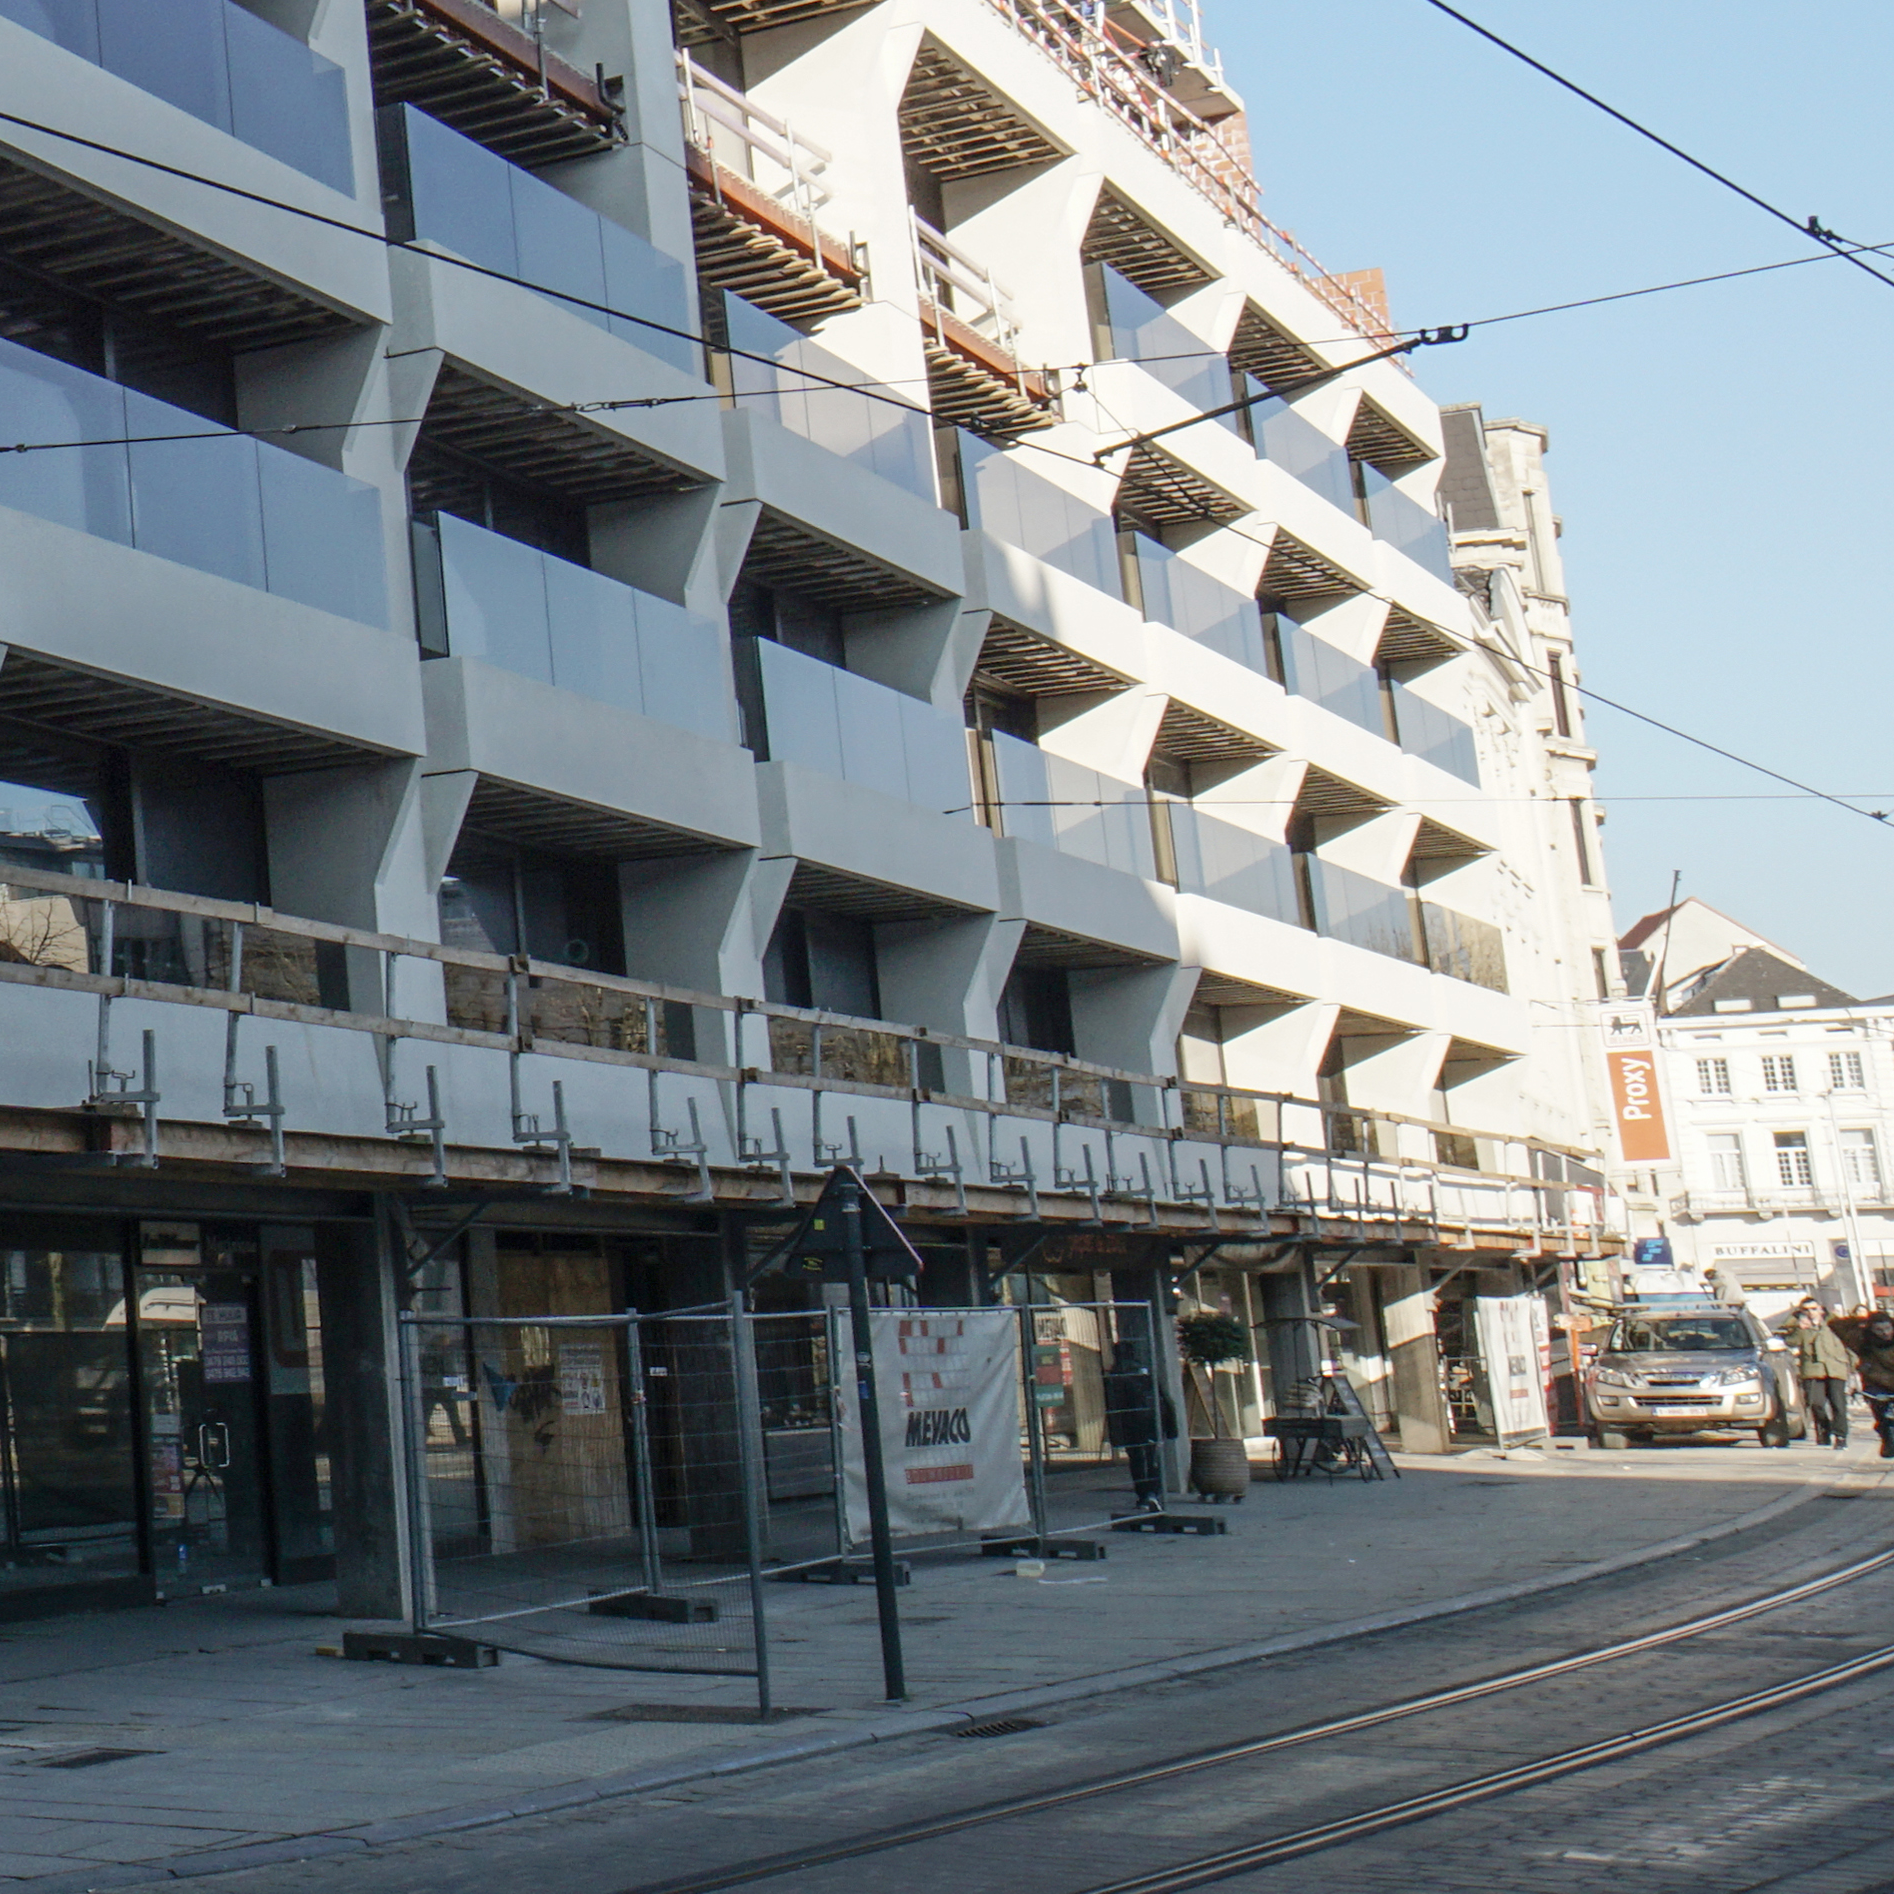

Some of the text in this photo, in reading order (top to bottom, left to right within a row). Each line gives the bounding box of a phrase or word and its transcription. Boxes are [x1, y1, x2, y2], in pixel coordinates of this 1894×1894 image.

[1621, 1058, 1652, 1120] Proxy
[1715, 1245, 1811, 1256] BUFFALINI
[905, 1408, 971, 1447] MEVACO
